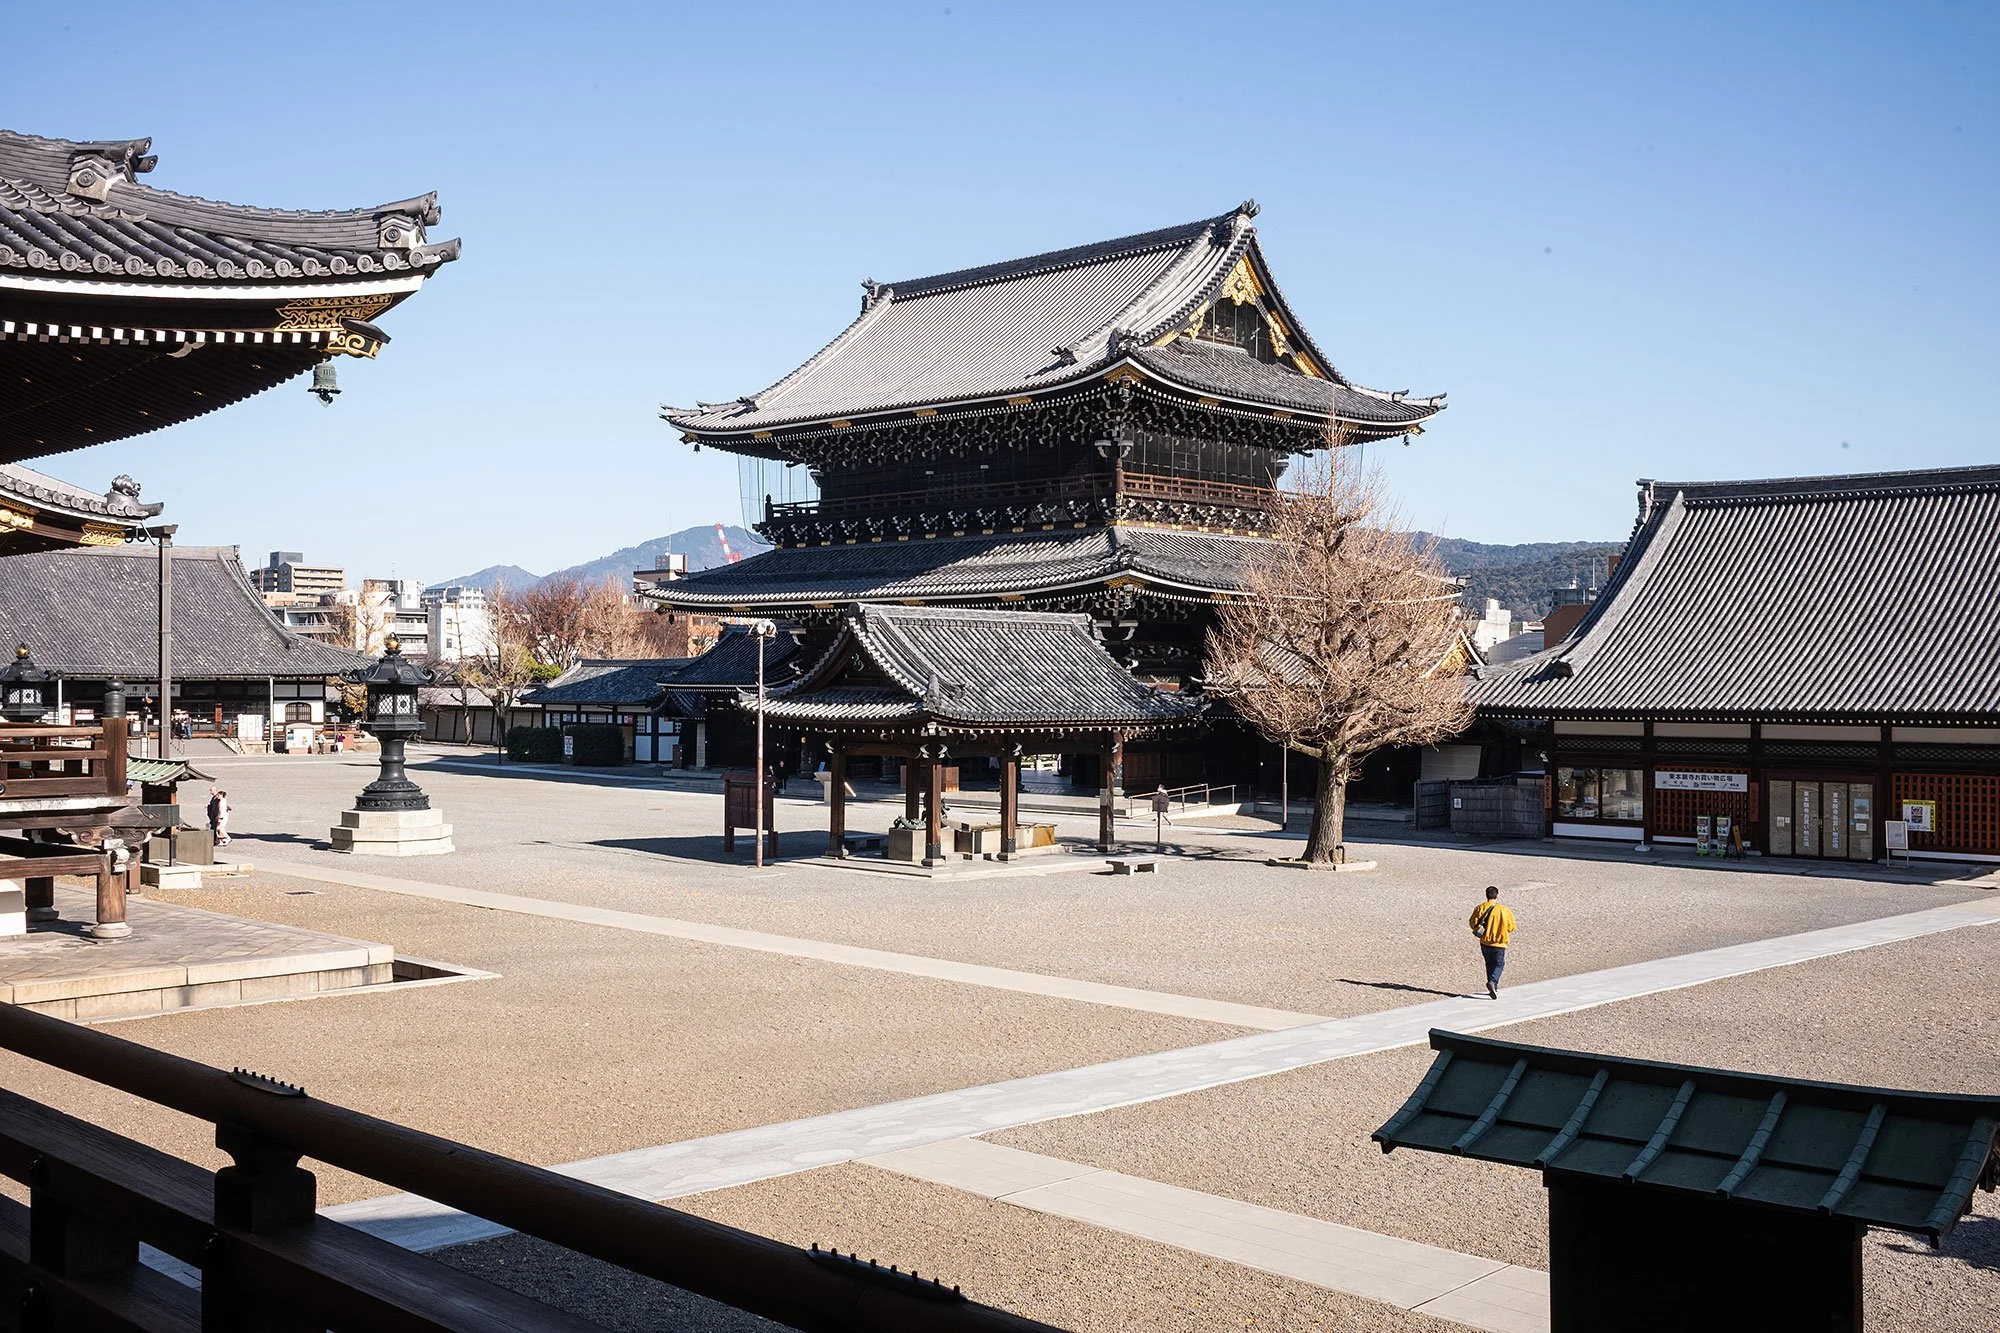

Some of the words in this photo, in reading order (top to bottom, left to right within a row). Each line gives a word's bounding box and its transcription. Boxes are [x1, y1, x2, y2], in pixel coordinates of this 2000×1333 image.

[1669, 773, 1733, 782] 東本願寺お買い物広場
